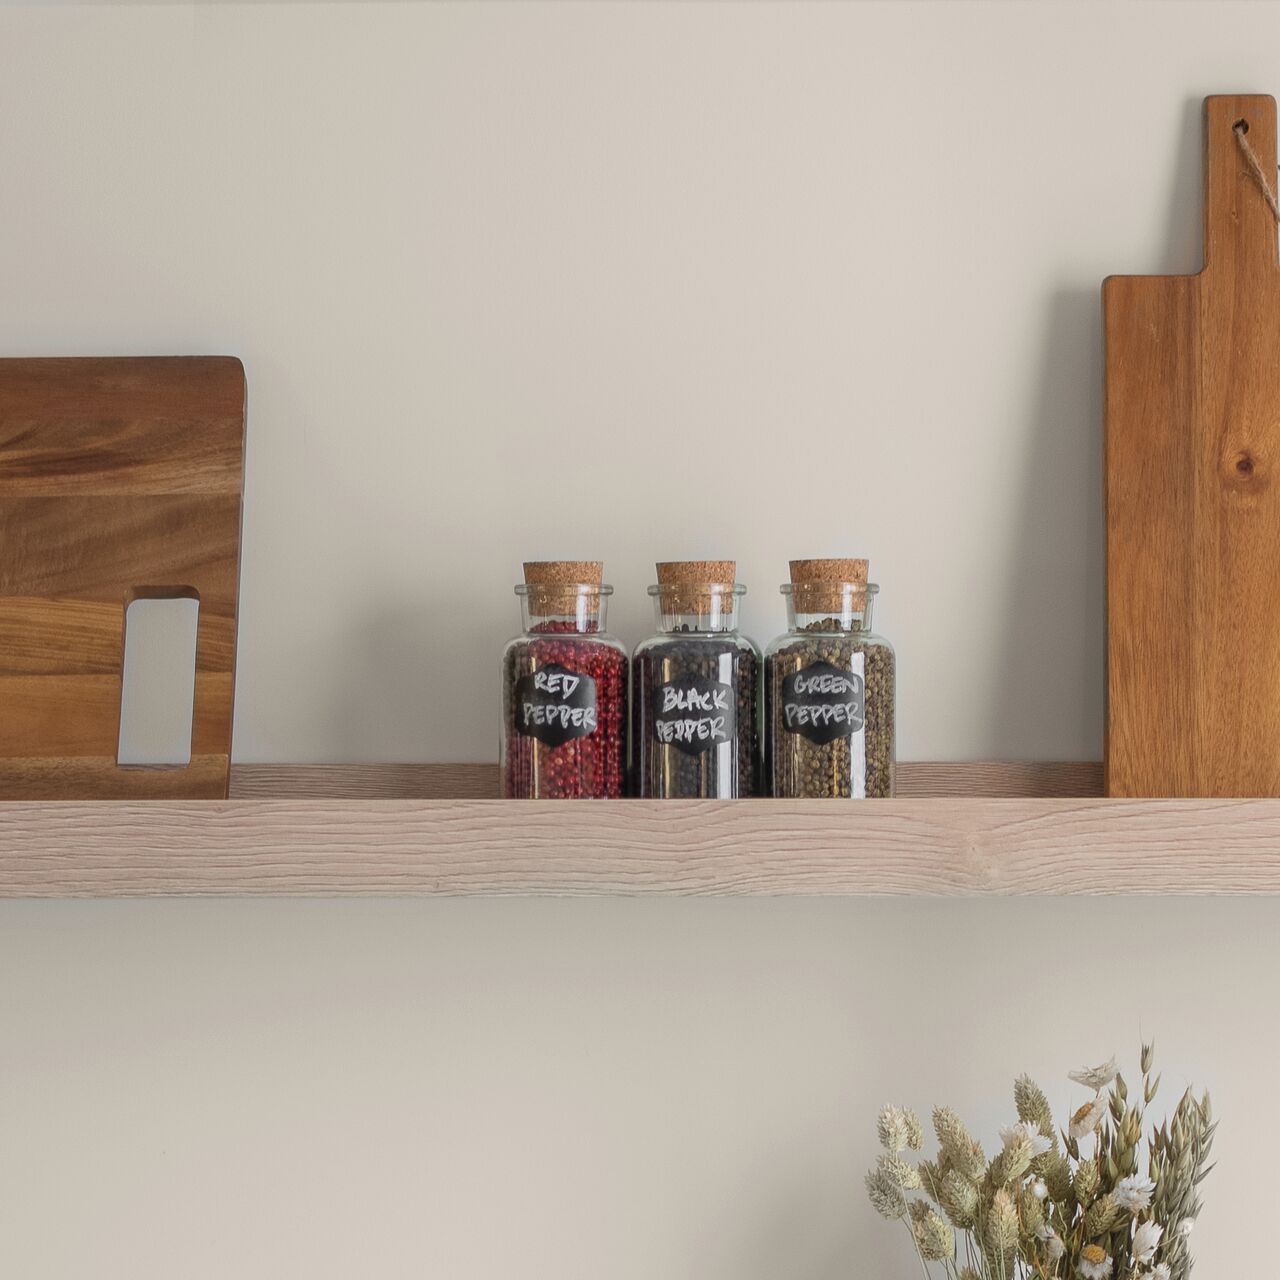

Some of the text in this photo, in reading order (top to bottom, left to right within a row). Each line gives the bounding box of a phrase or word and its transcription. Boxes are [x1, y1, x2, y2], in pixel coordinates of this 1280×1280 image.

[534, 671, 580, 700] RED
[793, 673, 859, 695] GREEN
[662, 686, 729, 713] BLACK
[523, 702, 597, 729] PEPPER
[784, 701, 863, 728] PEPPER
[655, 716, 727, 744] PEPPER
